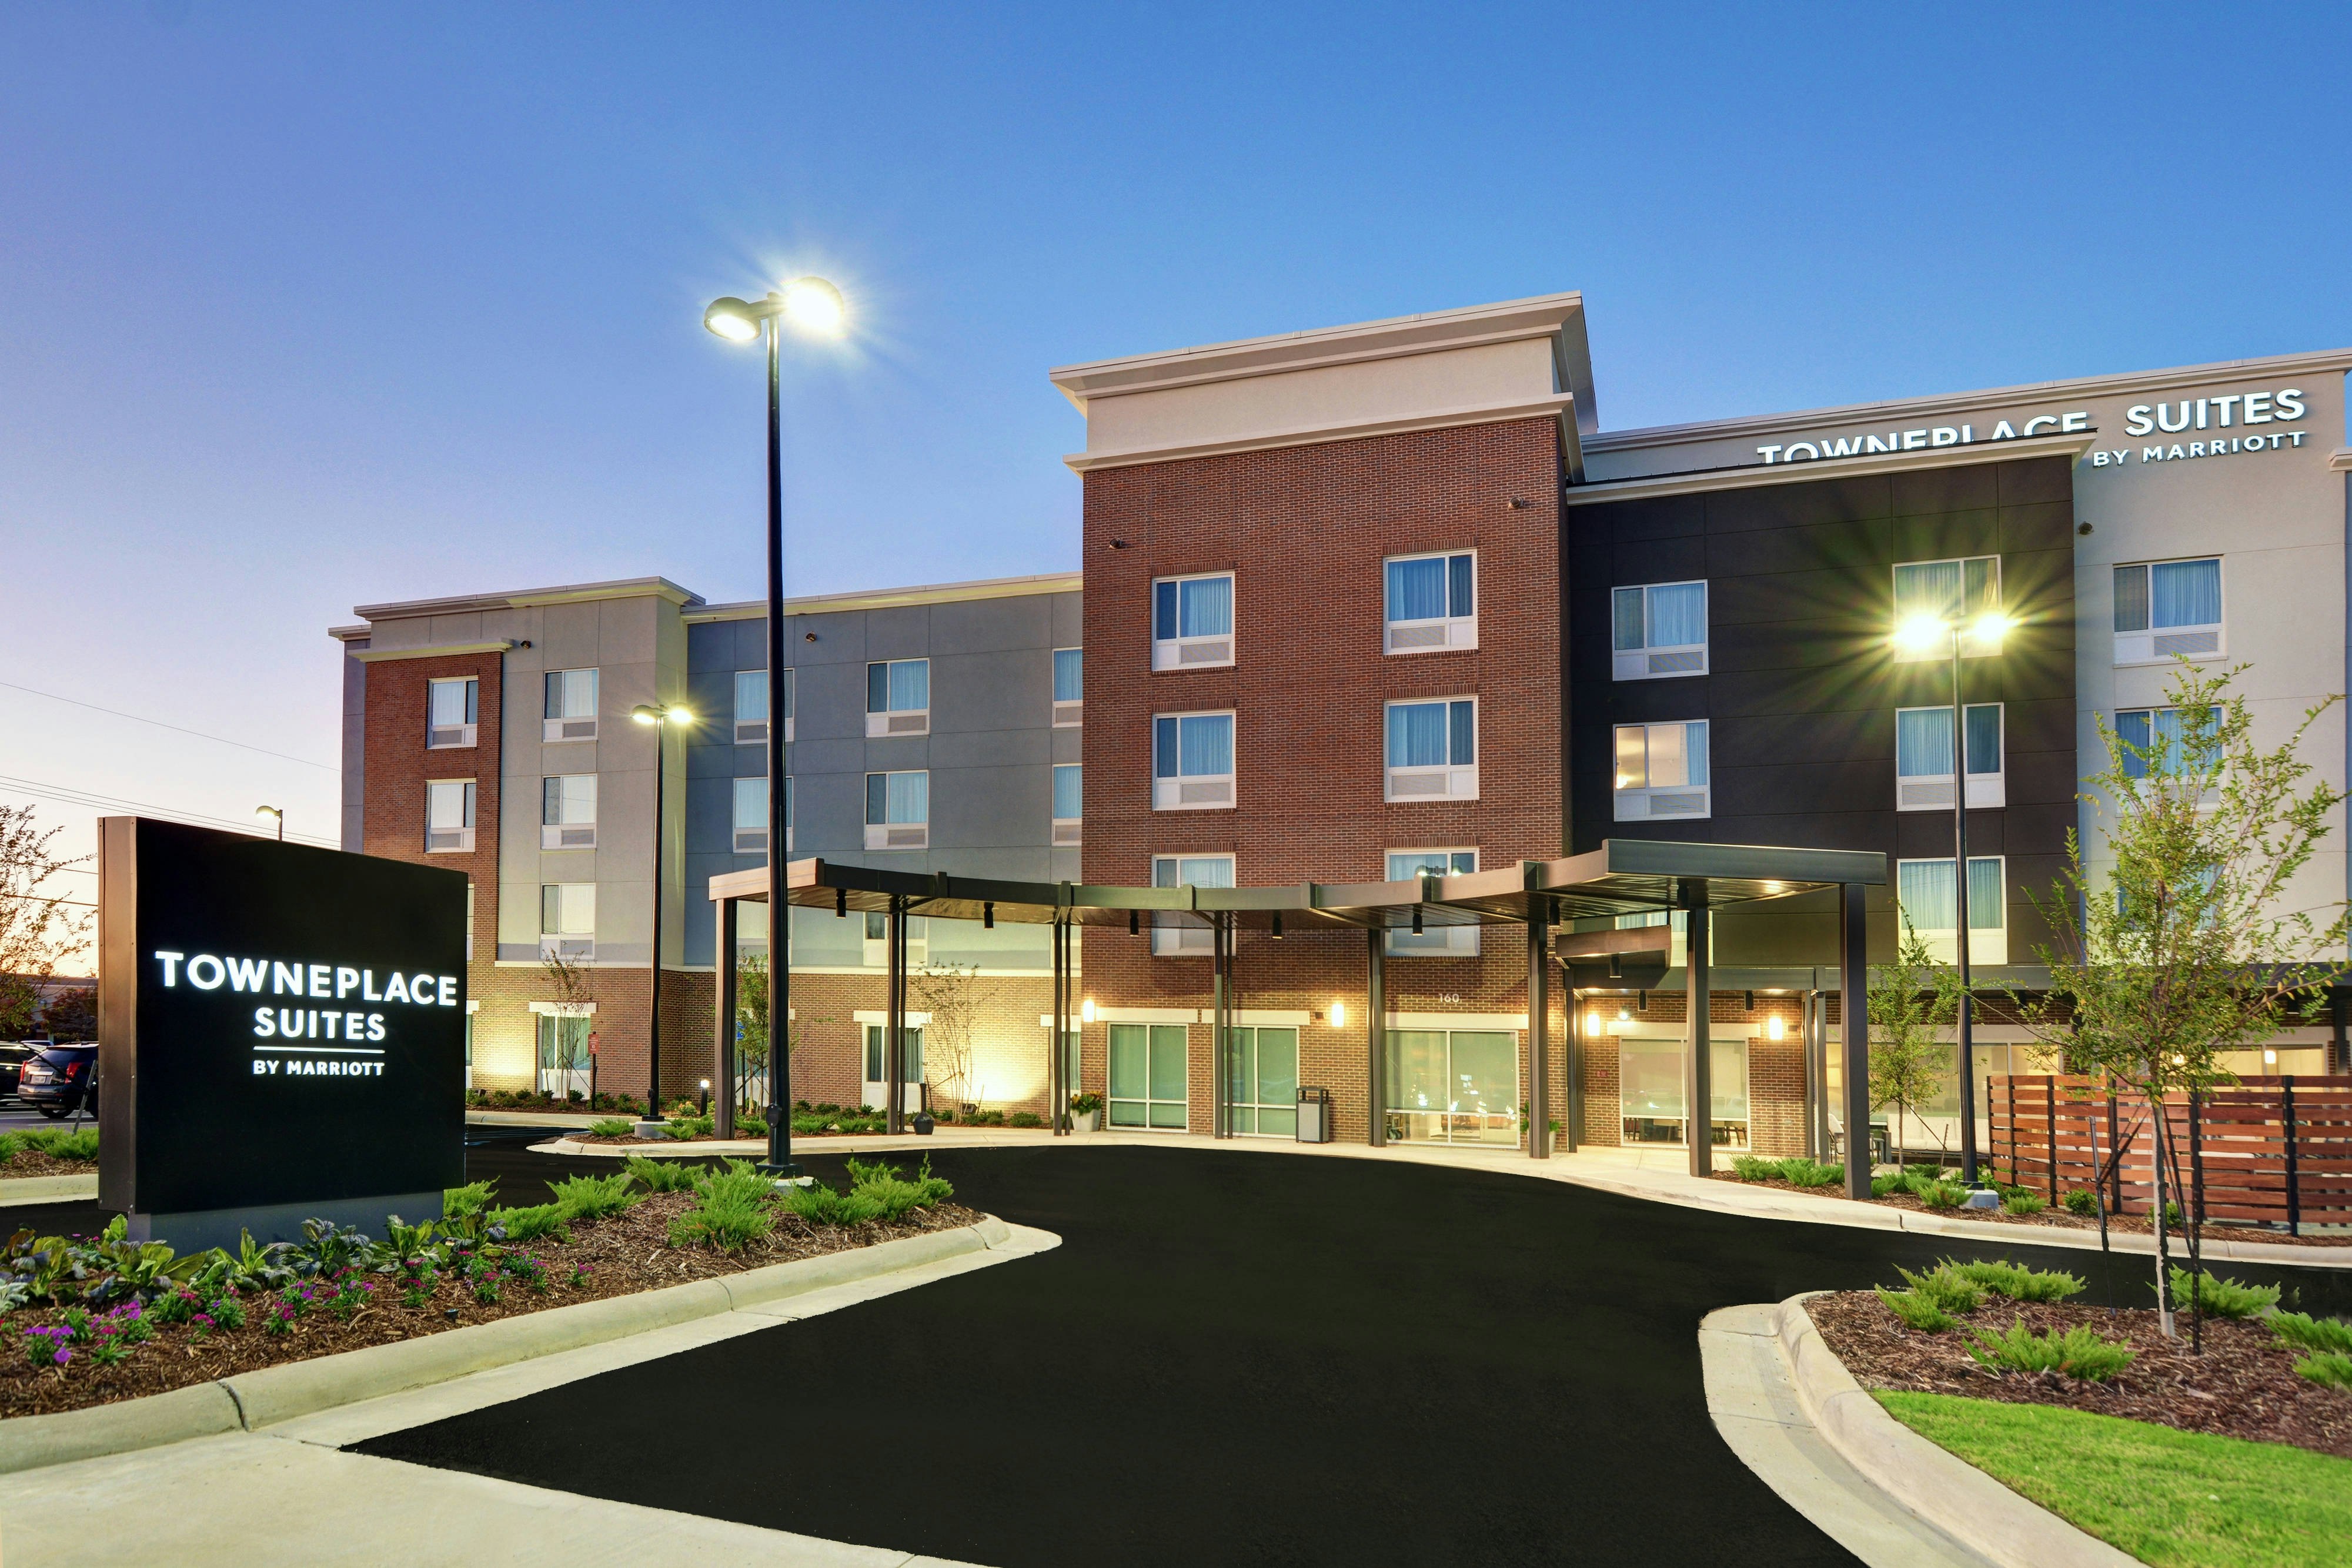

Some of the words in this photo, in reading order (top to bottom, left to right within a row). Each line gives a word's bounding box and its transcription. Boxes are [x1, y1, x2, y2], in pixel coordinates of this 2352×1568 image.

[2124, 388, 2306, 437] SUITES
[2093, 450, 2129, 467] BY
[2141, 430, 2306, 463] MARRIOTT
[155, 950, 457, 1007] TOWNEPLACE
[1439, 993, 1459, 1002] 160
[253, 1007, 386, 1041] SUITES
[253, 1059, 280, 1075] BY
[286, 1060, 386, 1076] MARRIOTT
